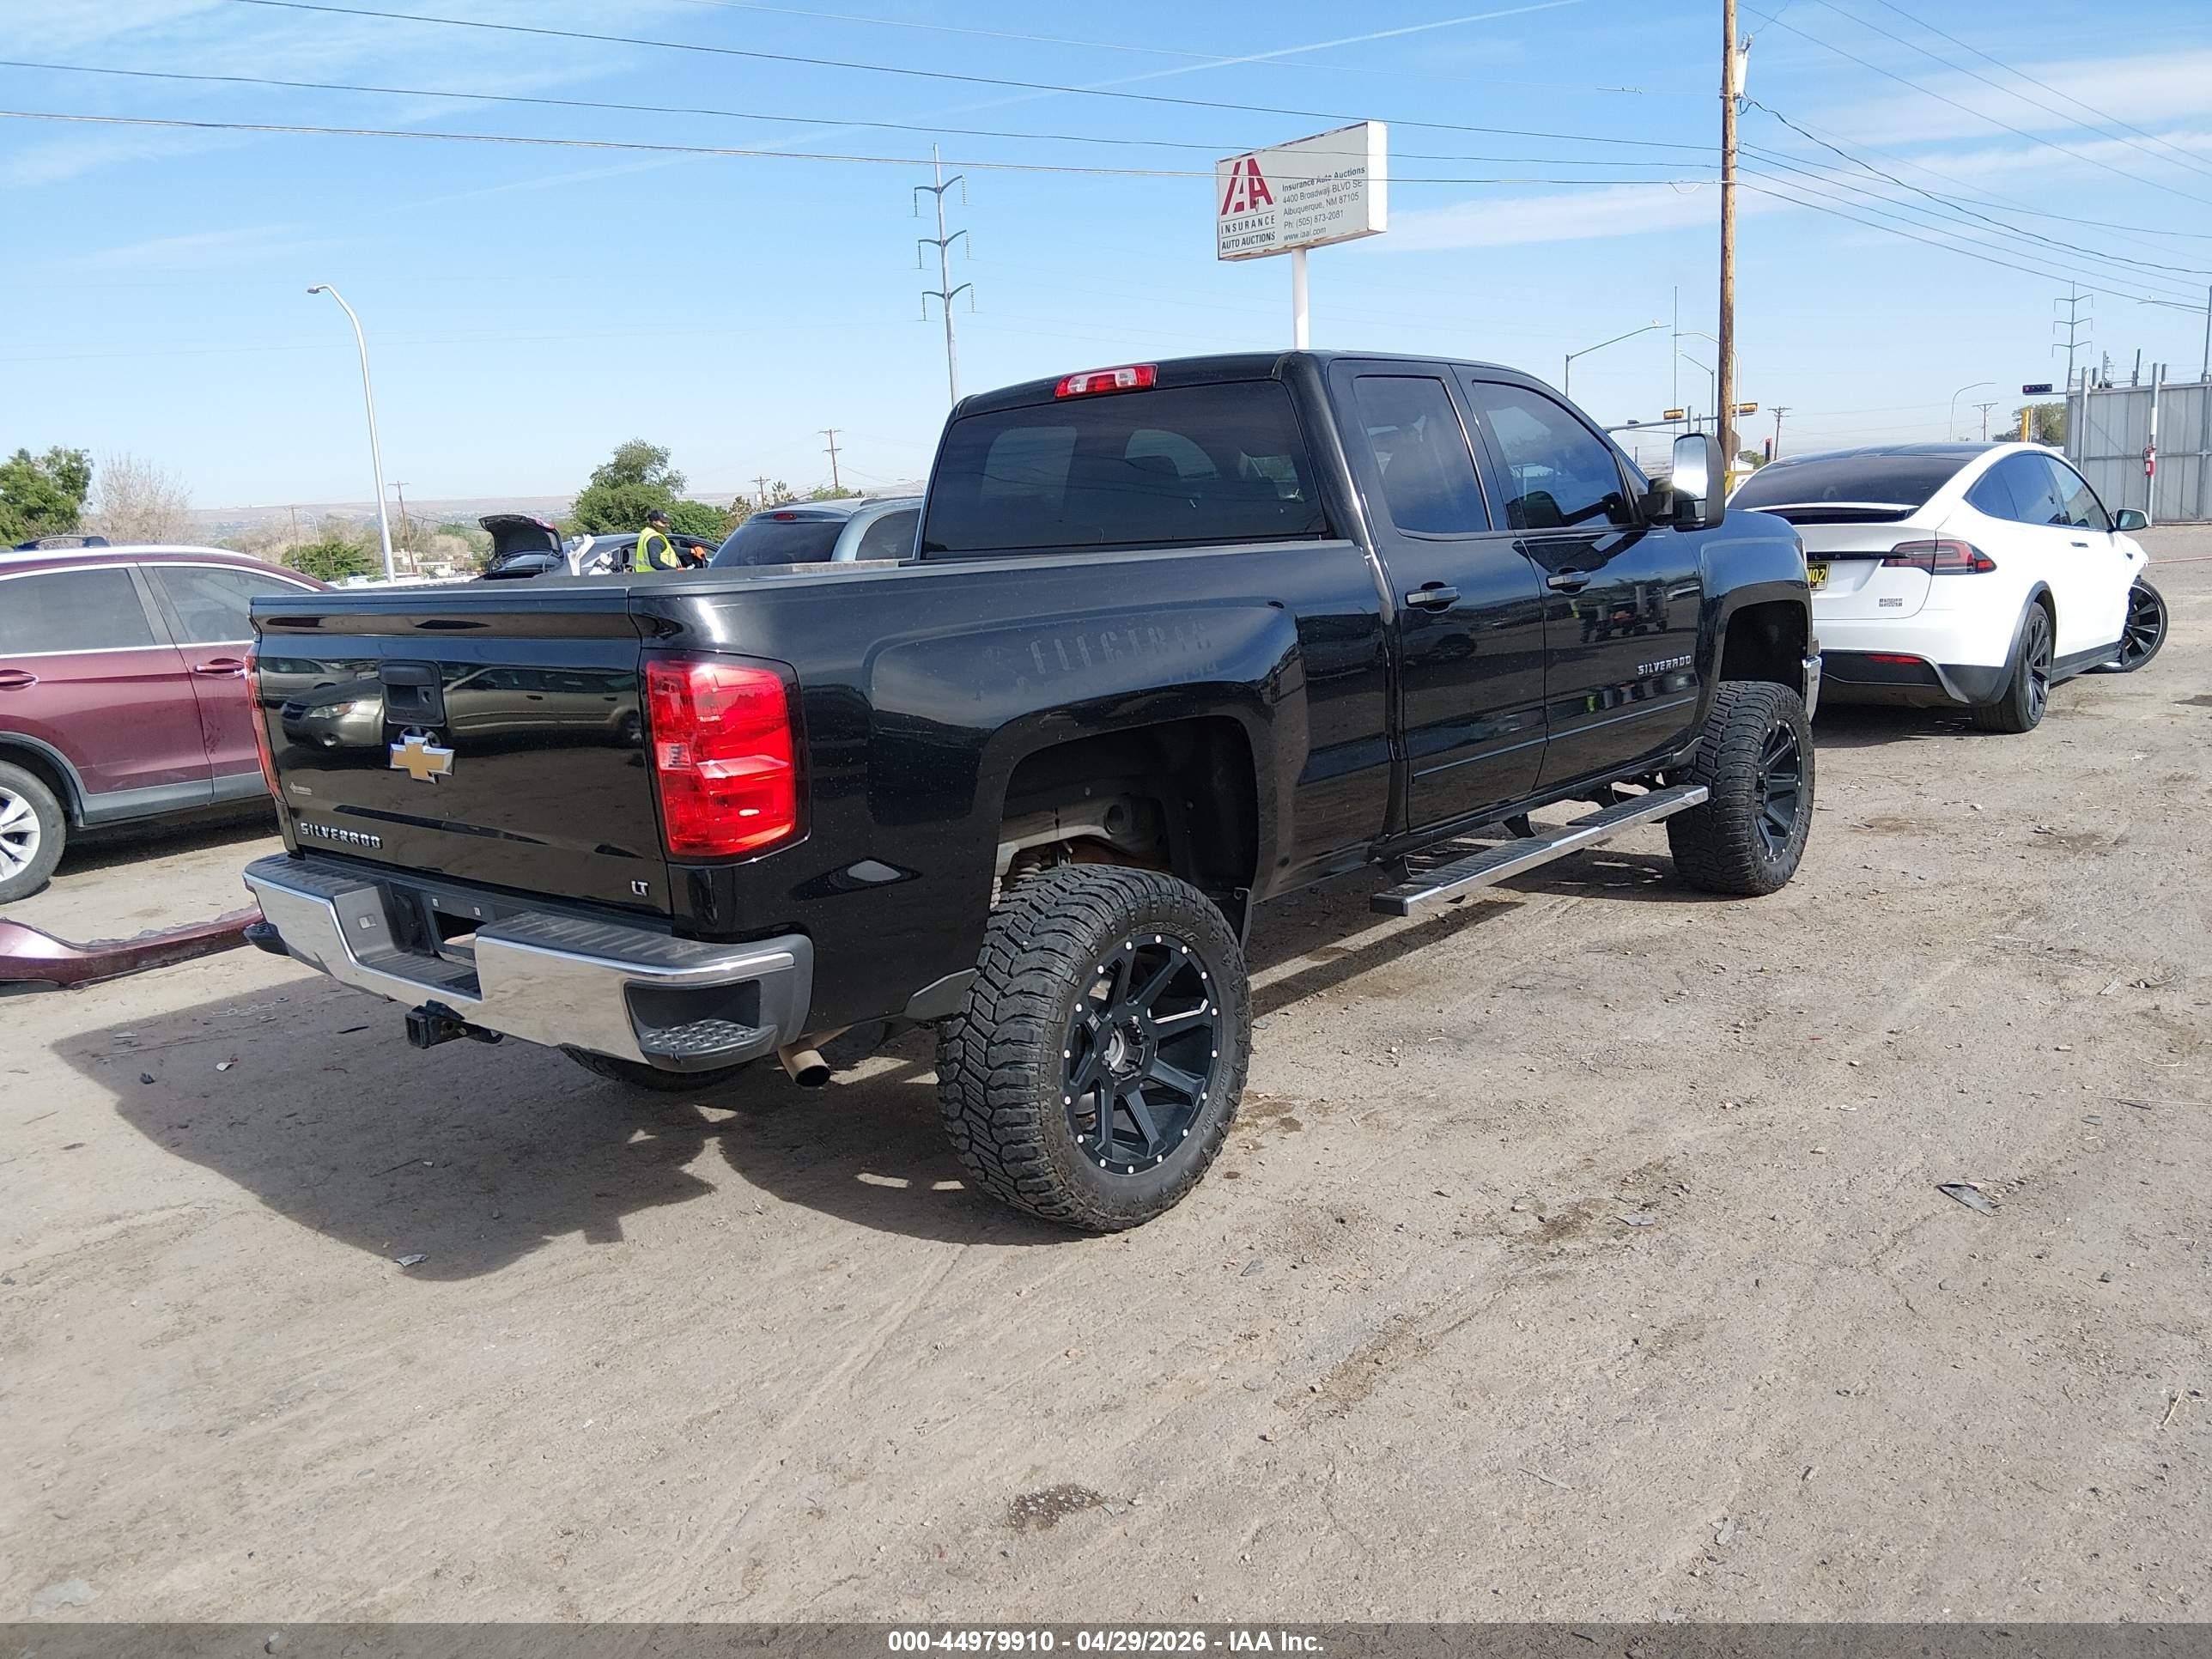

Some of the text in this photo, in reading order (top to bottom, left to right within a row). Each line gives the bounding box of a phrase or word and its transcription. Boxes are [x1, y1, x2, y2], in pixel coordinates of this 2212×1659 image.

[1282, 178, 1315, 192] Insurance
[1334, 167, 1365, 179] Auctions
[1283, 179, 1363, 204] 4400 Broadway BLVD SE
[1326, 197, 1337, 207] NM
[1339, 191, 1359, 204] 87105
[1221, 215, 1275, 234] INSURANCE
[1296, 216, 1313, 229] (505)
[1222, 231, 1276, 251] AUTO AUCTIONS
[1637, 655, 1692, 675] SILVERADO
[300, 822, 383, 849] SILVERADO
[631, 880, 649, 896] LT
